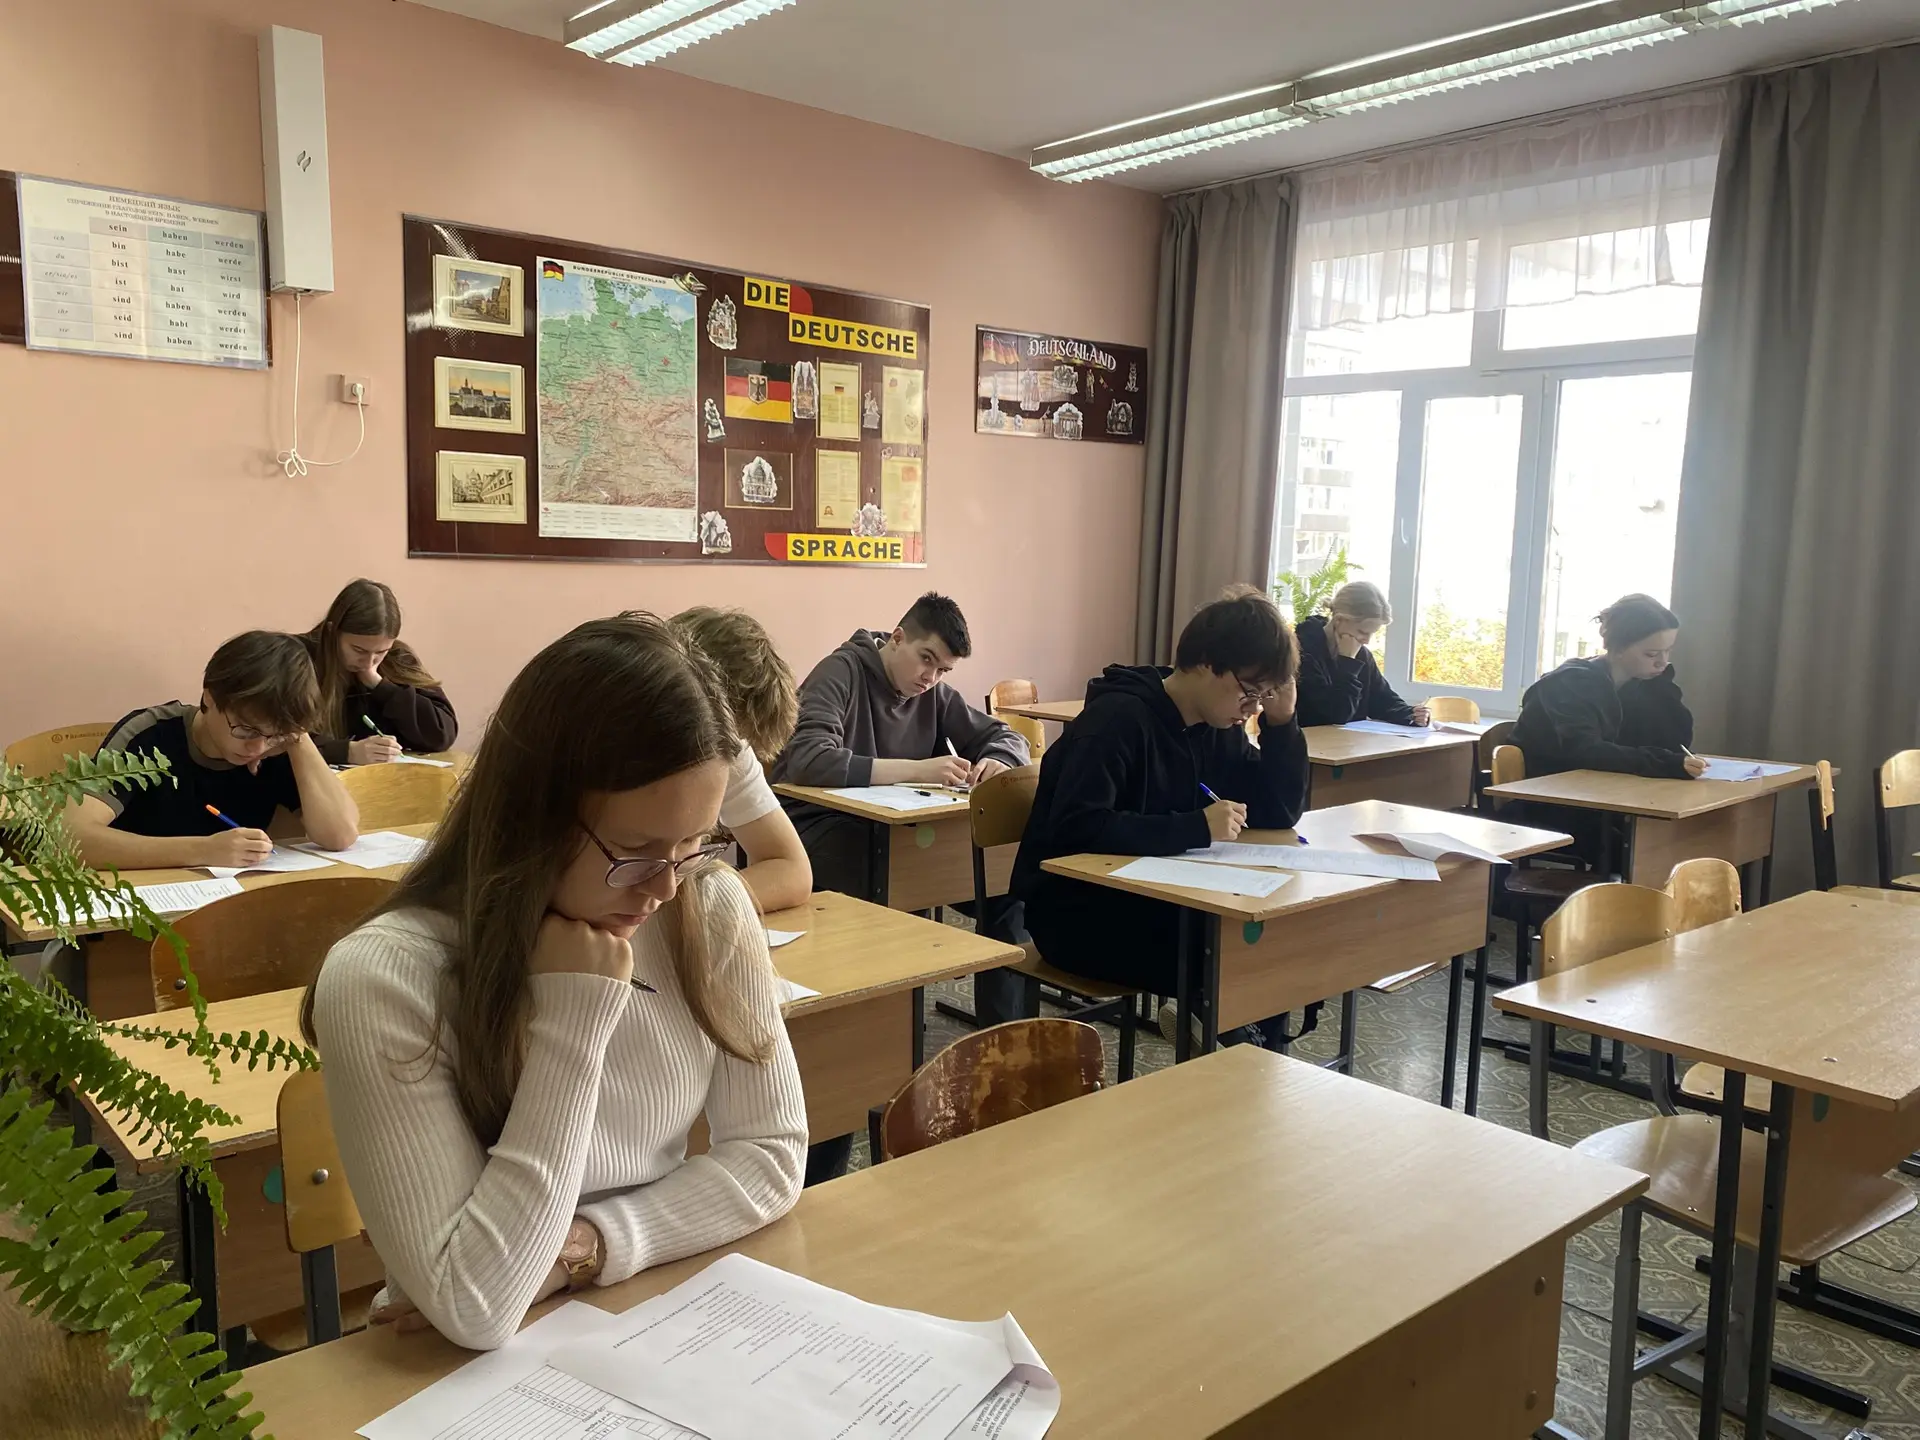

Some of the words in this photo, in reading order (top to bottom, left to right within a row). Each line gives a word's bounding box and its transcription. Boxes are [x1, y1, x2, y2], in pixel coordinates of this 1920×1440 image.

[108, 223, 128, 232] sein
[162, 231, 188, 241] haben
[112, 241, 126, 250] bin
[214, 240, 244, 249] werden
[166, 249, 187, 259] habe
[111, 258, 129, 268] bist
[218, 257, 242, 266] werde
[167, 266, 186, 275] hast
[115, 278, 127, 286] ist
[220, 274, 241, 282] wirst
[626, 273, 667, 285] DEUTSCHLAND
[170, 284, 185, 293] hat
[222, 291, 241, 299] wird
[747, 283, 789, 307] DIE
[112, 296, 131, 304] sind
[165, 301, 191, 311] haben
[217, 308, 247, 317] werden
[113, 313, 132, 322] seid
[169, 319, 188, 328] habt
[219, 325, 246, 334] werdet
[114, 331, 133, 340] sind
[792, 319, 914, 354] DEUTSCHE
[167, 336, 192, 345] haben
[219, 342, 248, 351] werden
[1027, 338, 1117, 372] DEUTSCHLAND
[791, 538, 902, 560] SPRACHE
